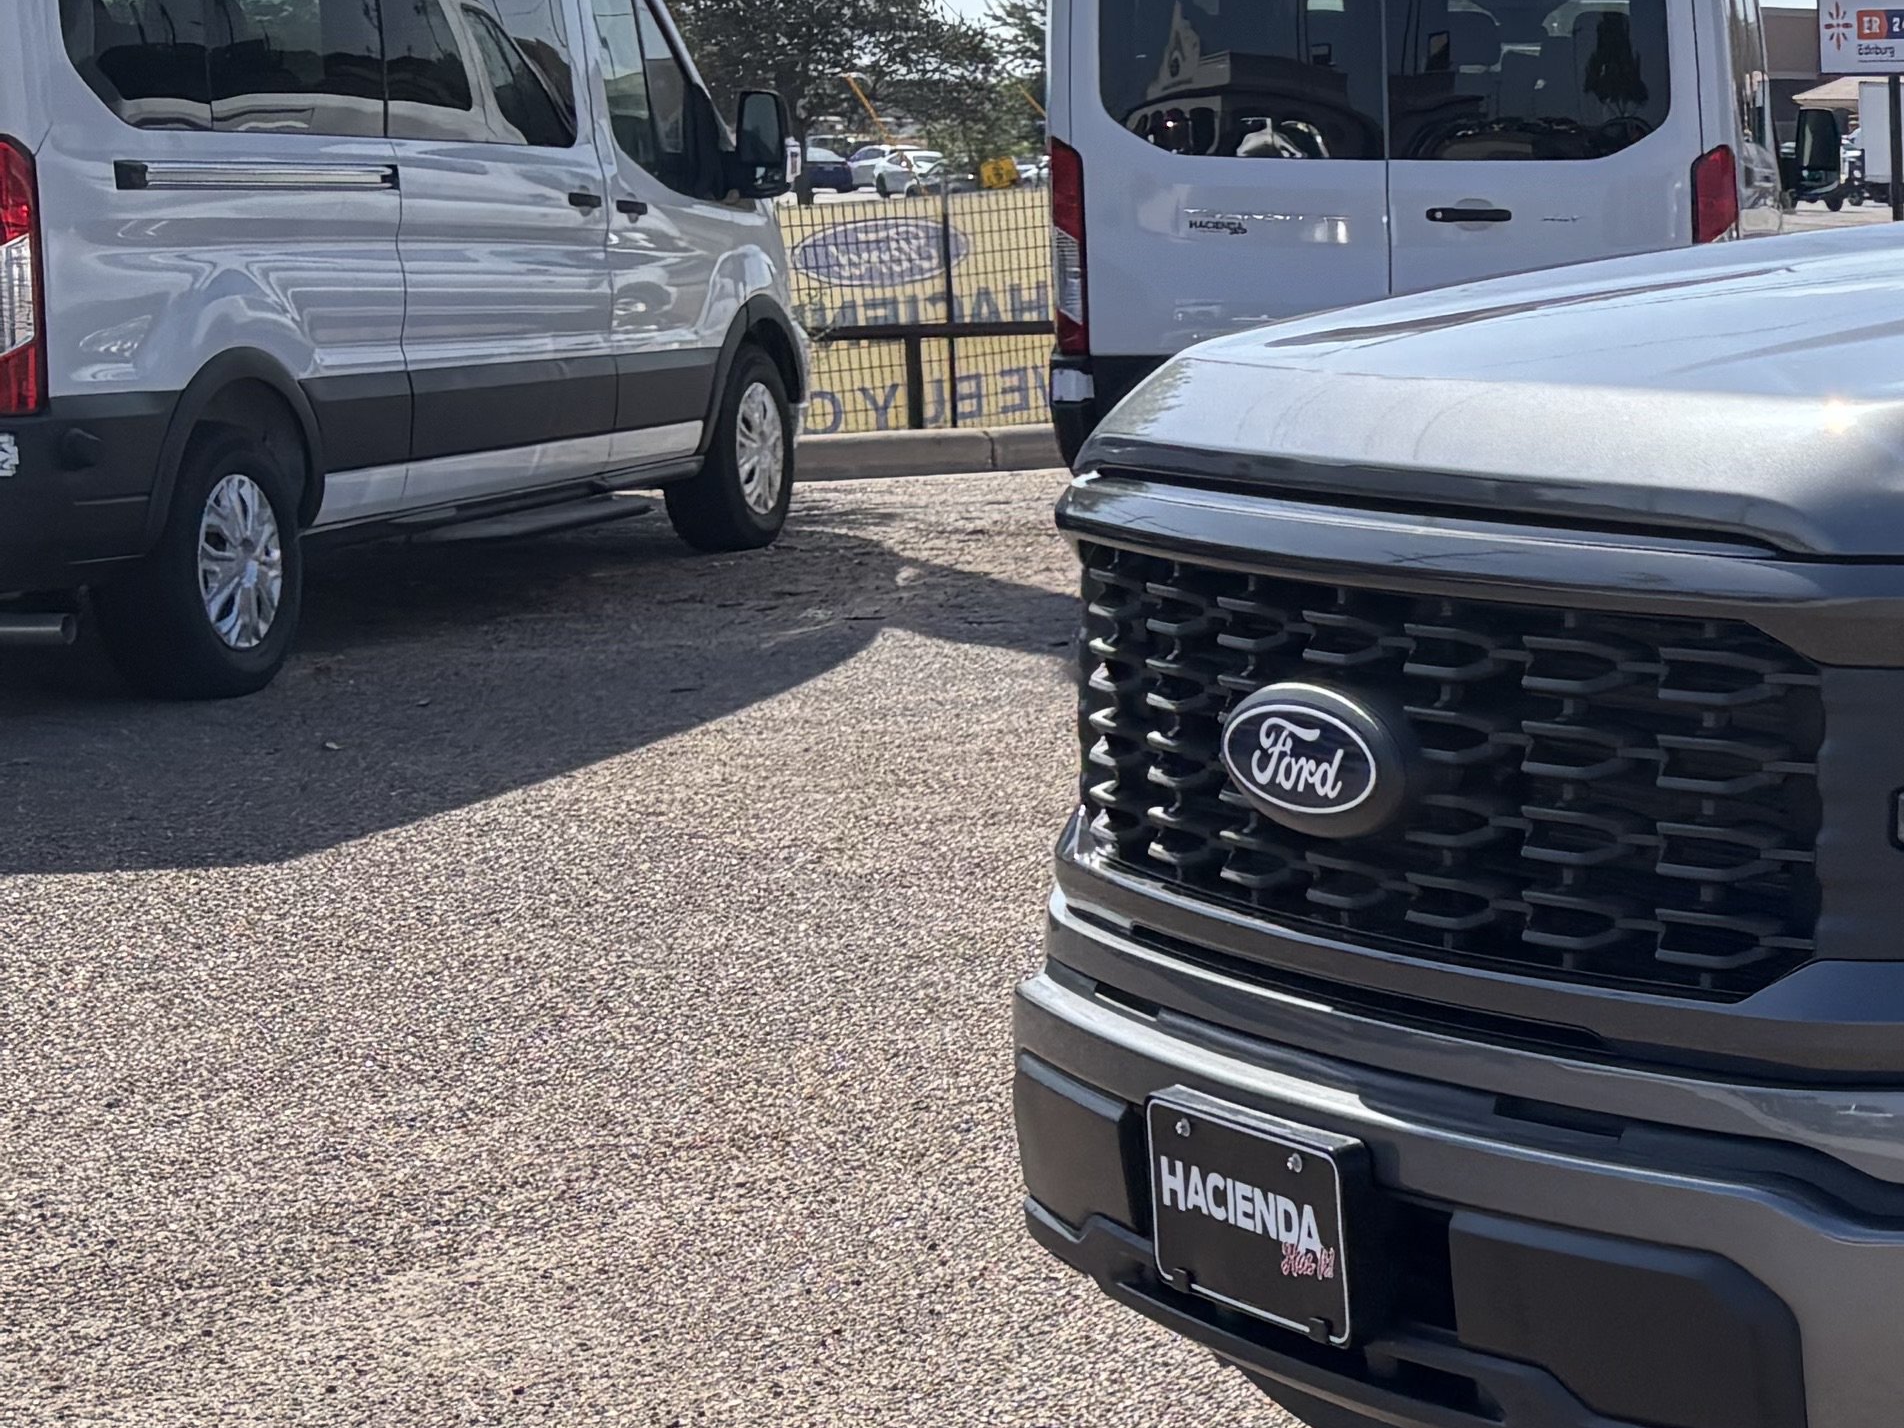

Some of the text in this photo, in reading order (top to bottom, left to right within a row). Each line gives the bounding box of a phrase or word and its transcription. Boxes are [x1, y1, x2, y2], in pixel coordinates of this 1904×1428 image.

[1862, 16, 1881, 34] ER
[1251, 716, 1344, 800] Ford
[1160, 1155, 1323, 1257] HACIENDA
